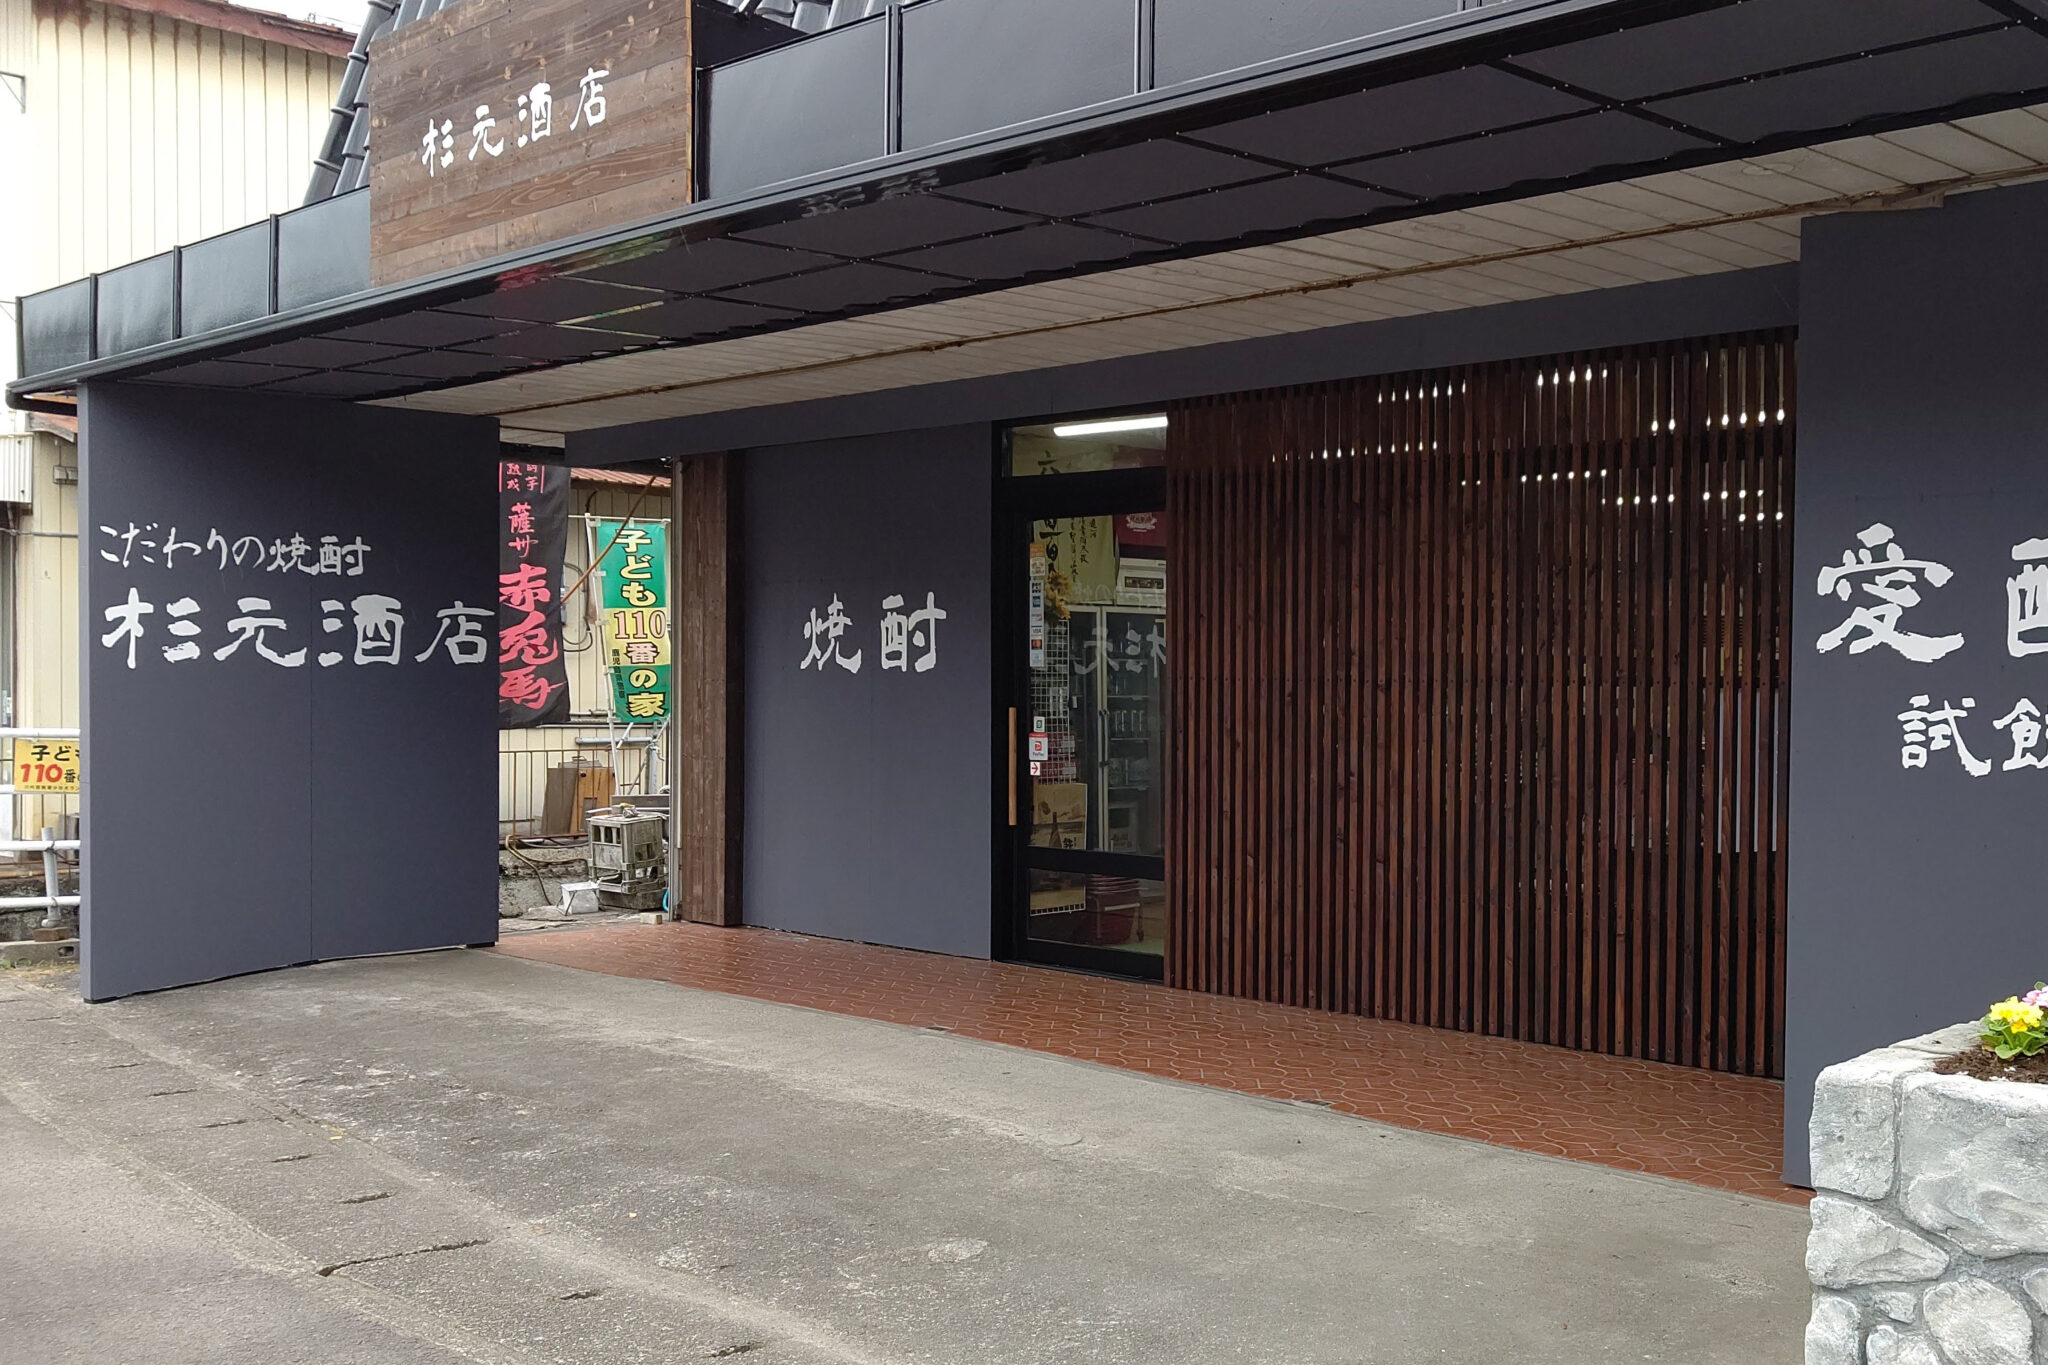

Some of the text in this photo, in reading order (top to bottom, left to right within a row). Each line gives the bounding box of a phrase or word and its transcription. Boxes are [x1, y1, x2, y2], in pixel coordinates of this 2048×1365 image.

[421, 66, 610, 177] 杉元酒店
[100, 522, 371, 576] こだわりの焼酎
[101, 588, 495, 669] 杉元酒店
[614, 528, 668, 718] 子ども110番の家
[800, 591, 947, 674] 焼酎
[20, 763, 80, 783] 110番
